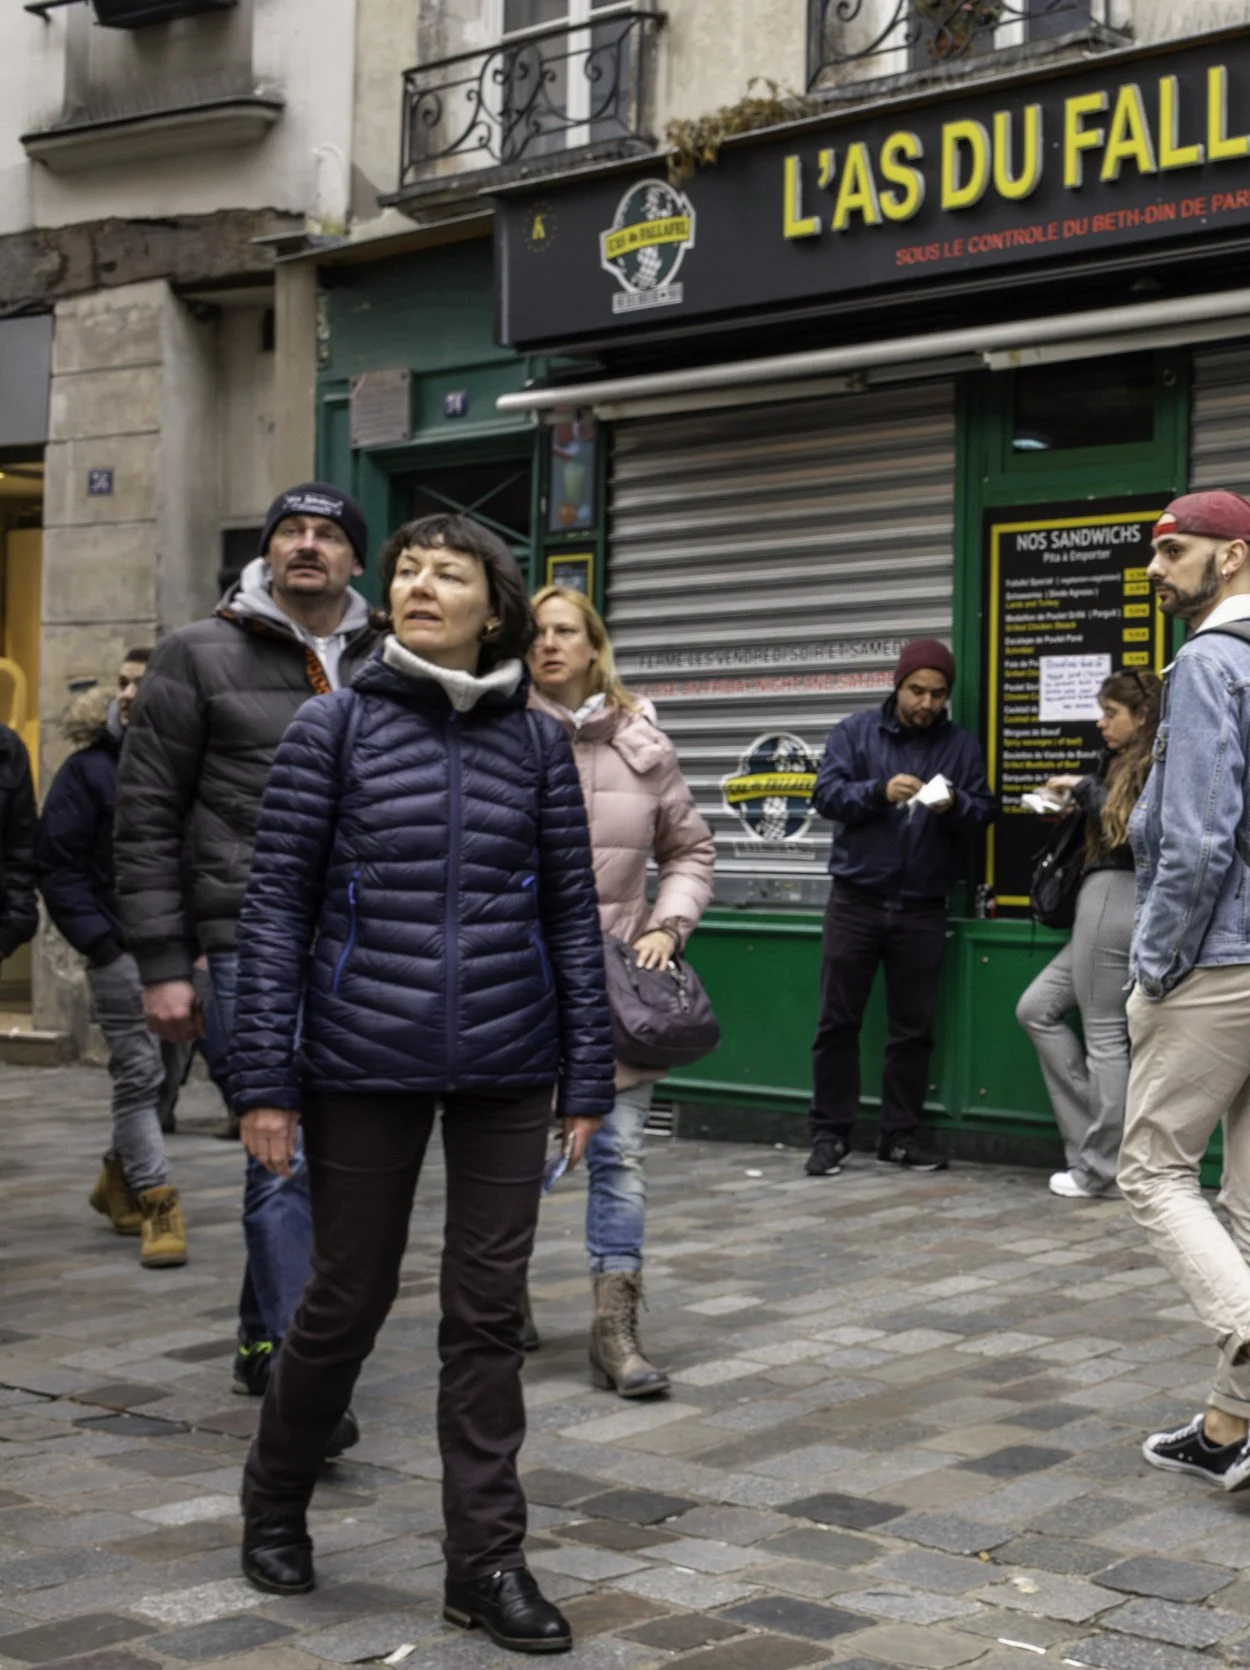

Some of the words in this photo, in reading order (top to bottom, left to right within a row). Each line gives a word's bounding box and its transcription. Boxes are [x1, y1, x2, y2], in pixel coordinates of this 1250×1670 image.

[941, 103, 1043, 210] DU
[895, 243, 941, 266] SOUS
[943, 239, 965, 259] LE
[967, 220, 1059, 254] CONTROLE
[1062, 217, 1089, 239] DU
[1092, 201, 1177, 233] BETH-DIN
[1181, 195, 1207, 218] DE
[1016, 532, 1048, 551] NOS
[1050, 525, 1142, 550] SANDWICHS
